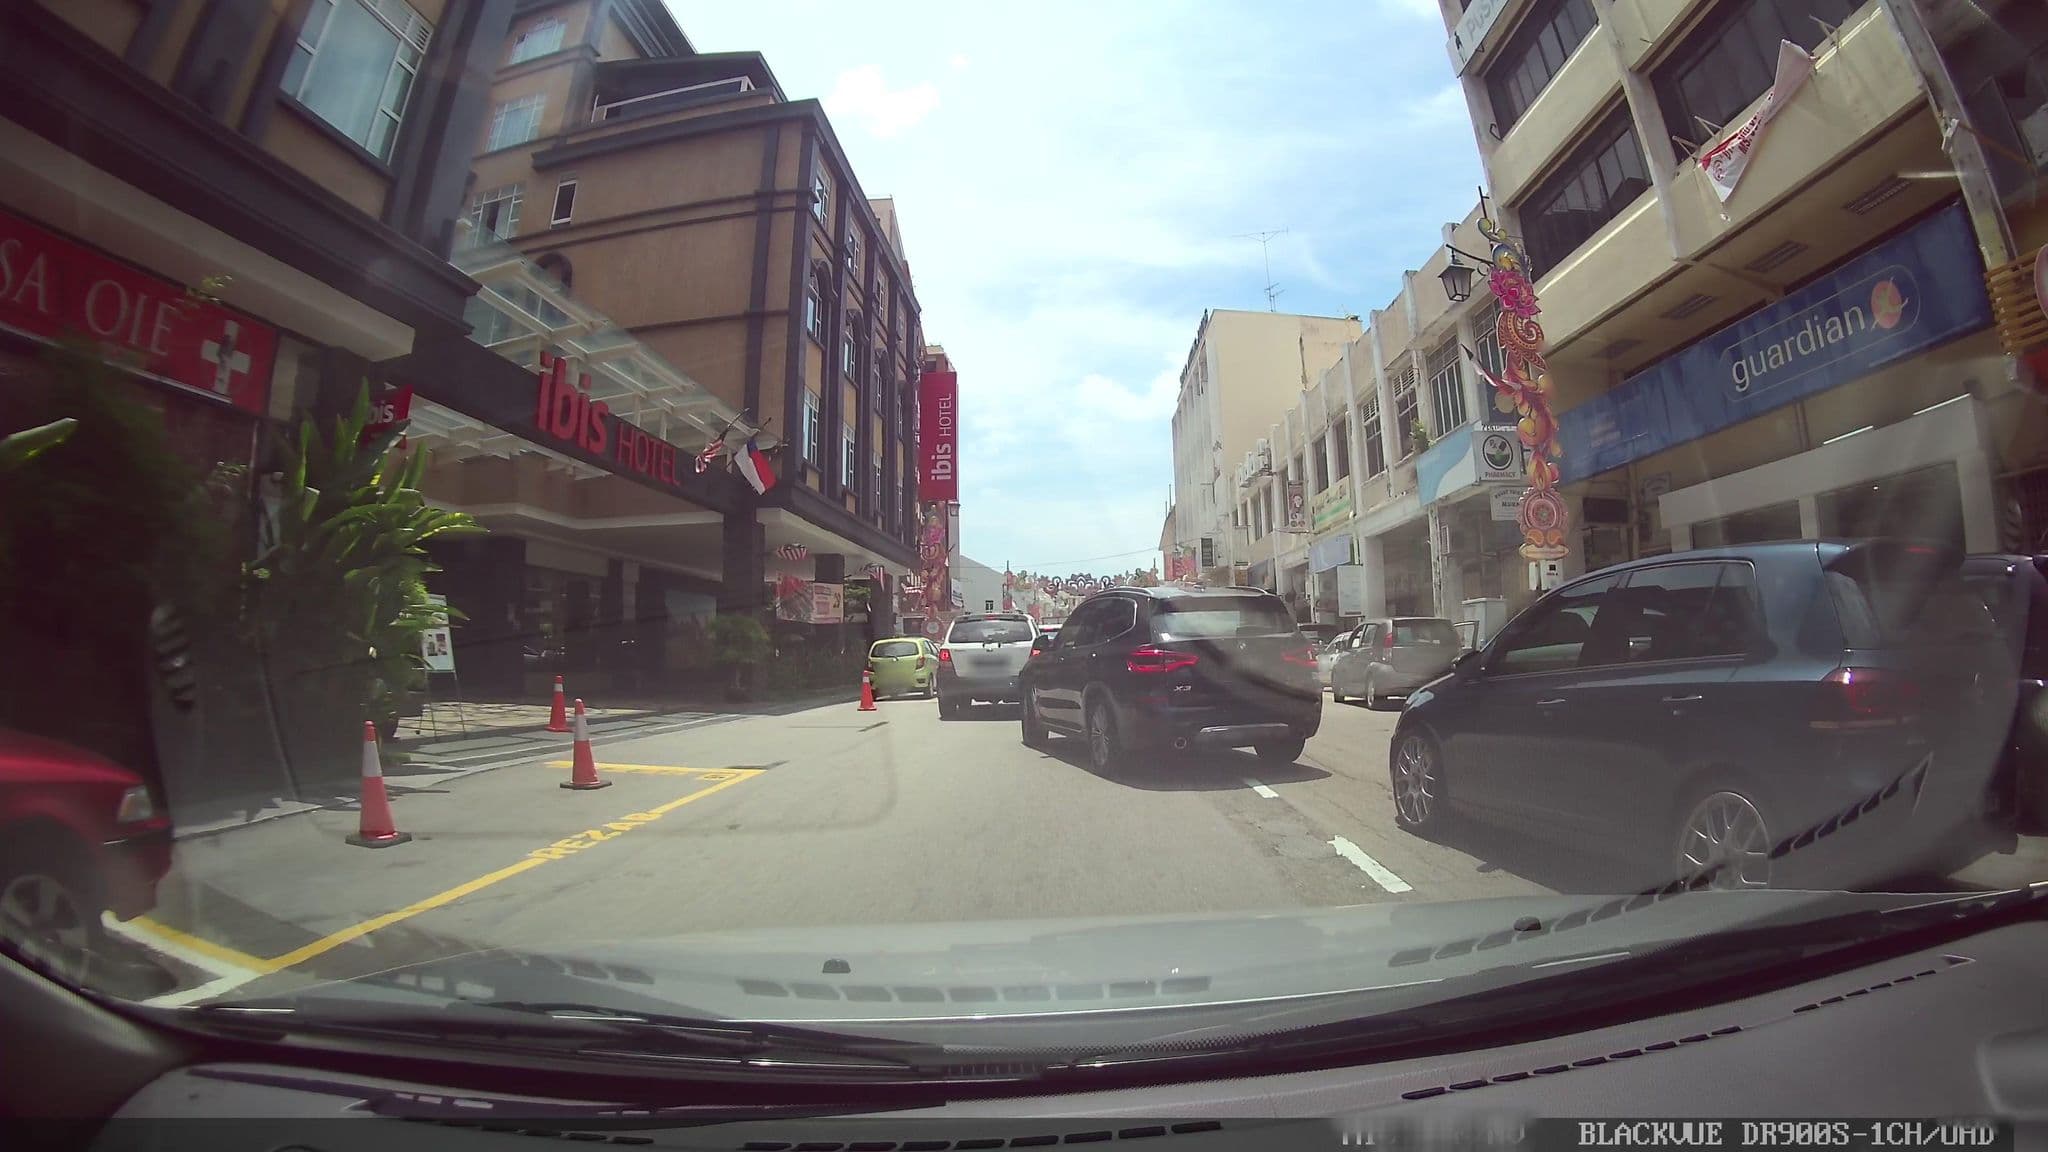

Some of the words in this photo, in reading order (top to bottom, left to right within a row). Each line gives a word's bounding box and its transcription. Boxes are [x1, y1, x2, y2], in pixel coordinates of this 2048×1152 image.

[1732, 304, 1866, 392] guardian
[536, 351, 609, 453] ibis
[616, 421, 680, 486] HOTEL
[939, 393, 951, 436] HOTEL
[931, 443, 951, 480] ibis
